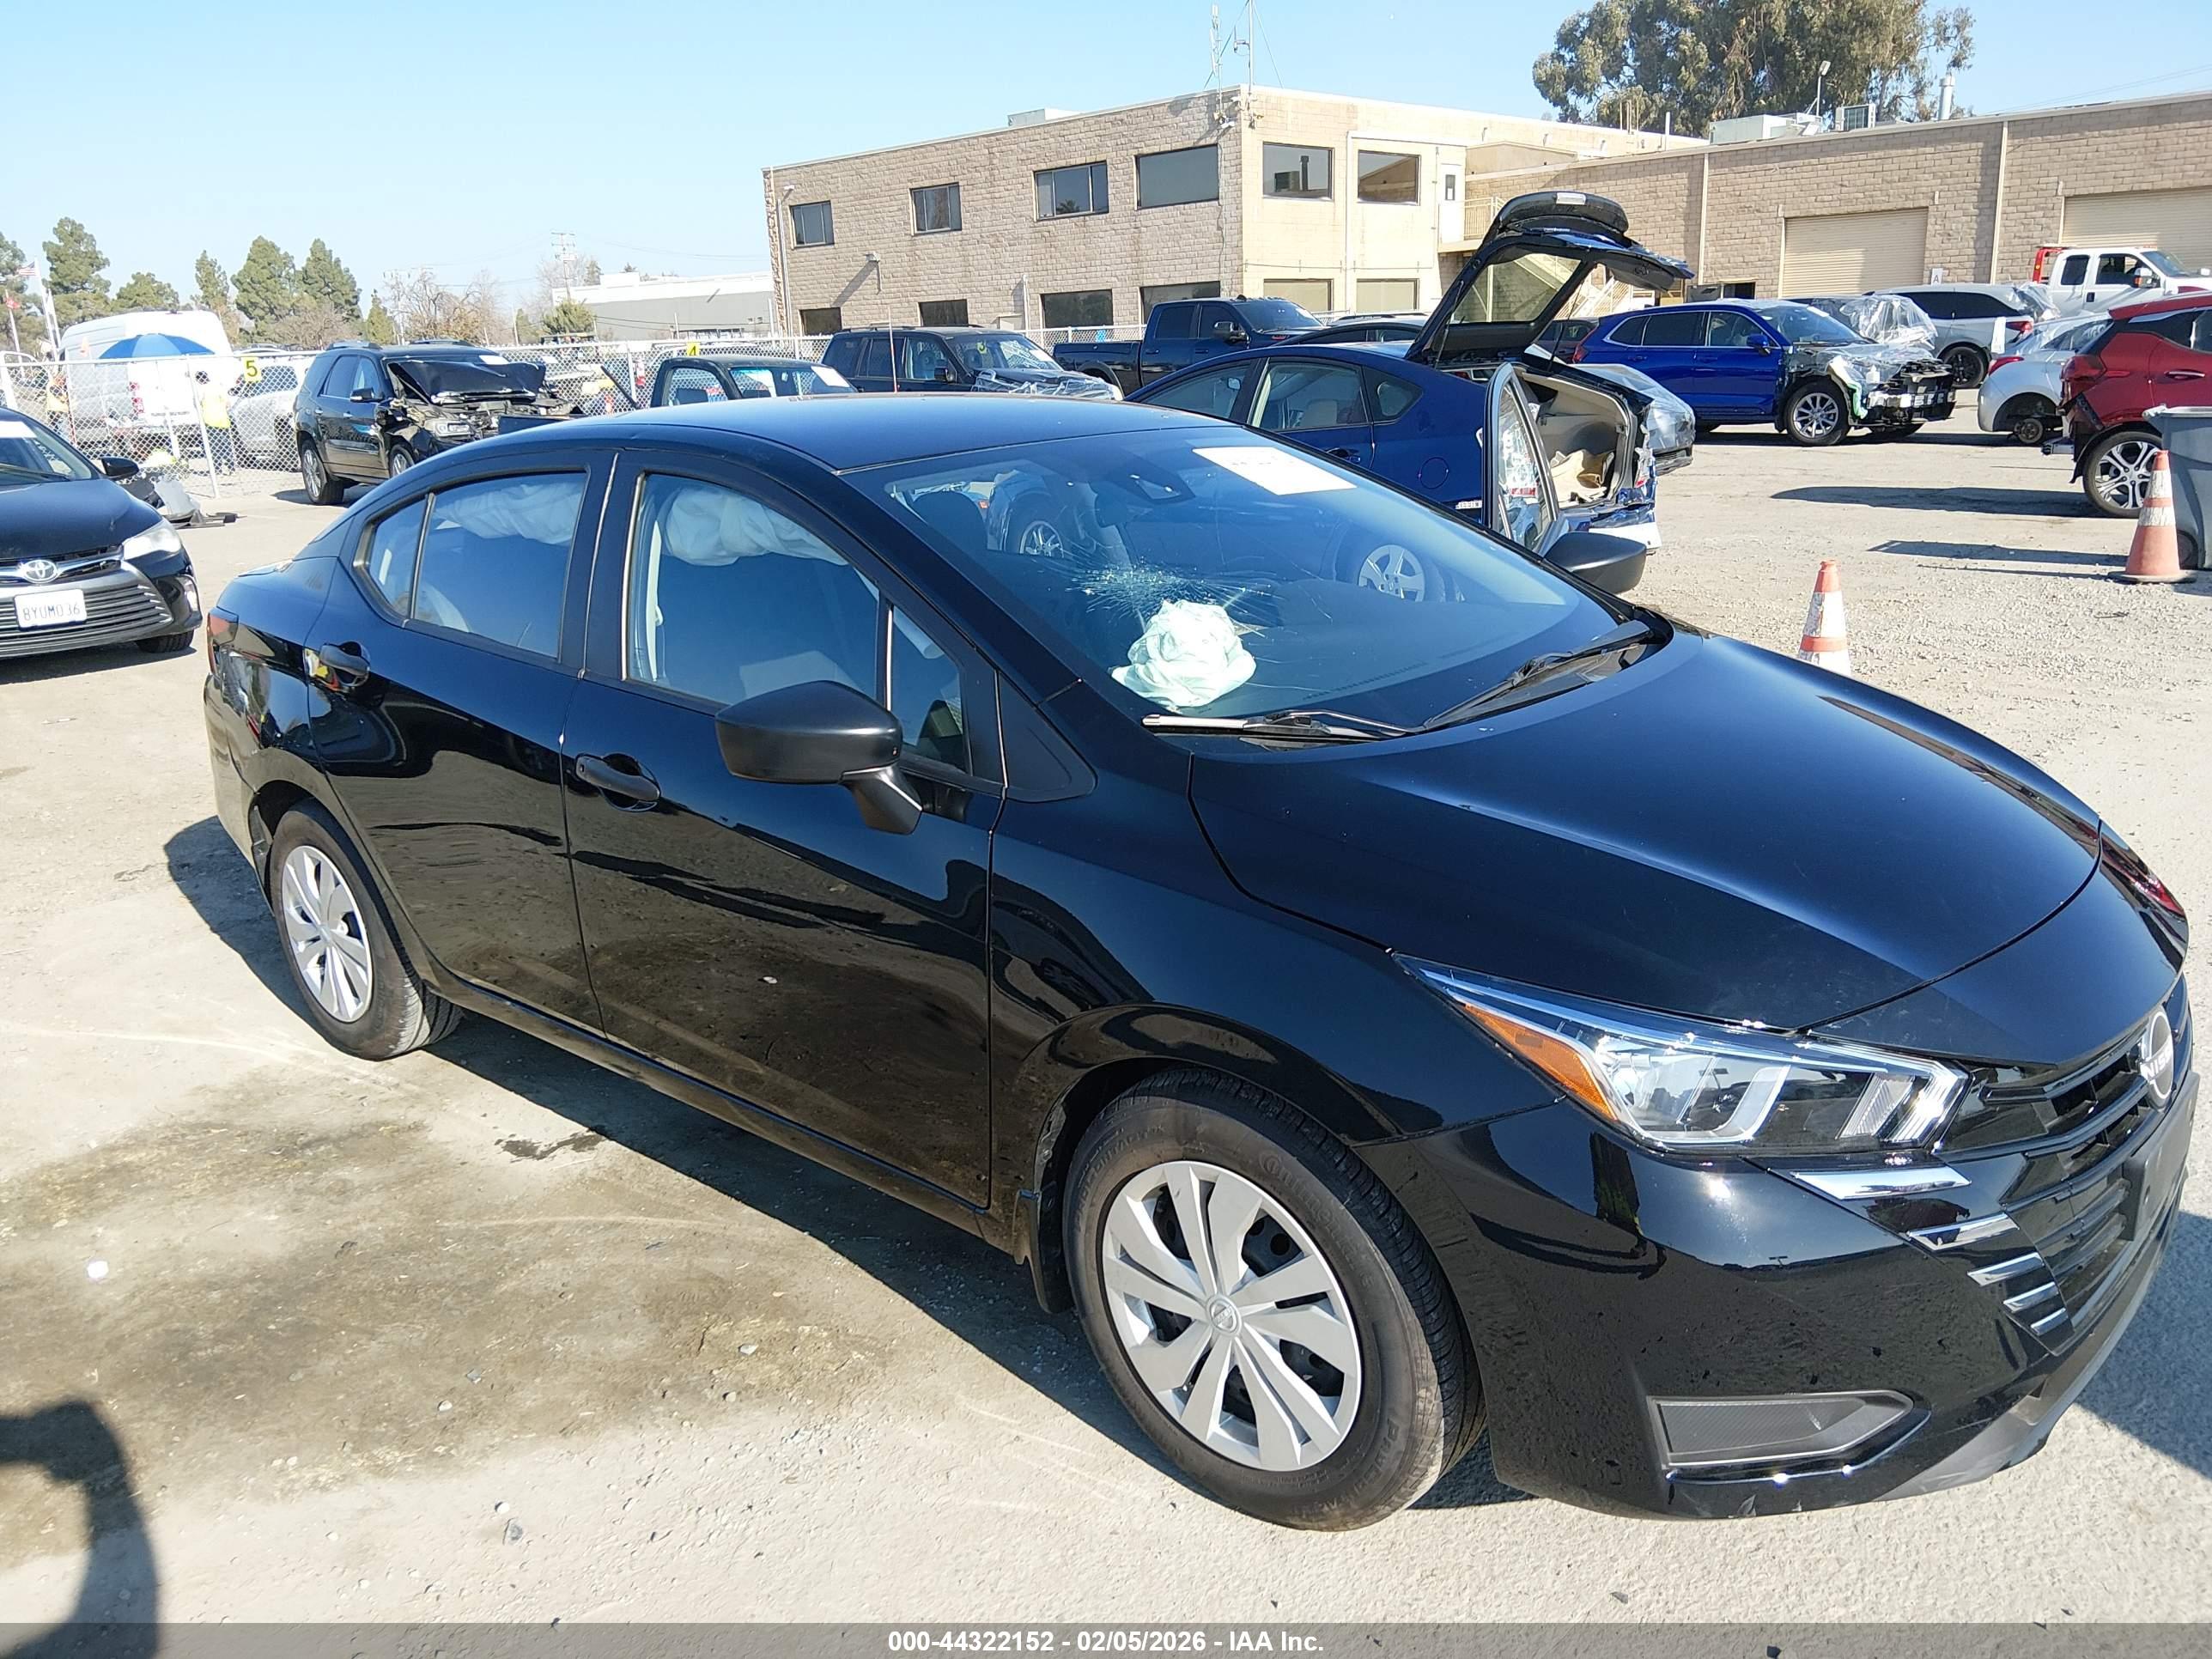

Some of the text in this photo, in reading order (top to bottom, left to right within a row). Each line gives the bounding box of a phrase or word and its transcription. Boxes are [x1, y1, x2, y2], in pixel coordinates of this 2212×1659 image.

[1933, 274, 1940, 283] A
[689, 345, 696, 356] 4
[246, 360, 258, 378] 5
